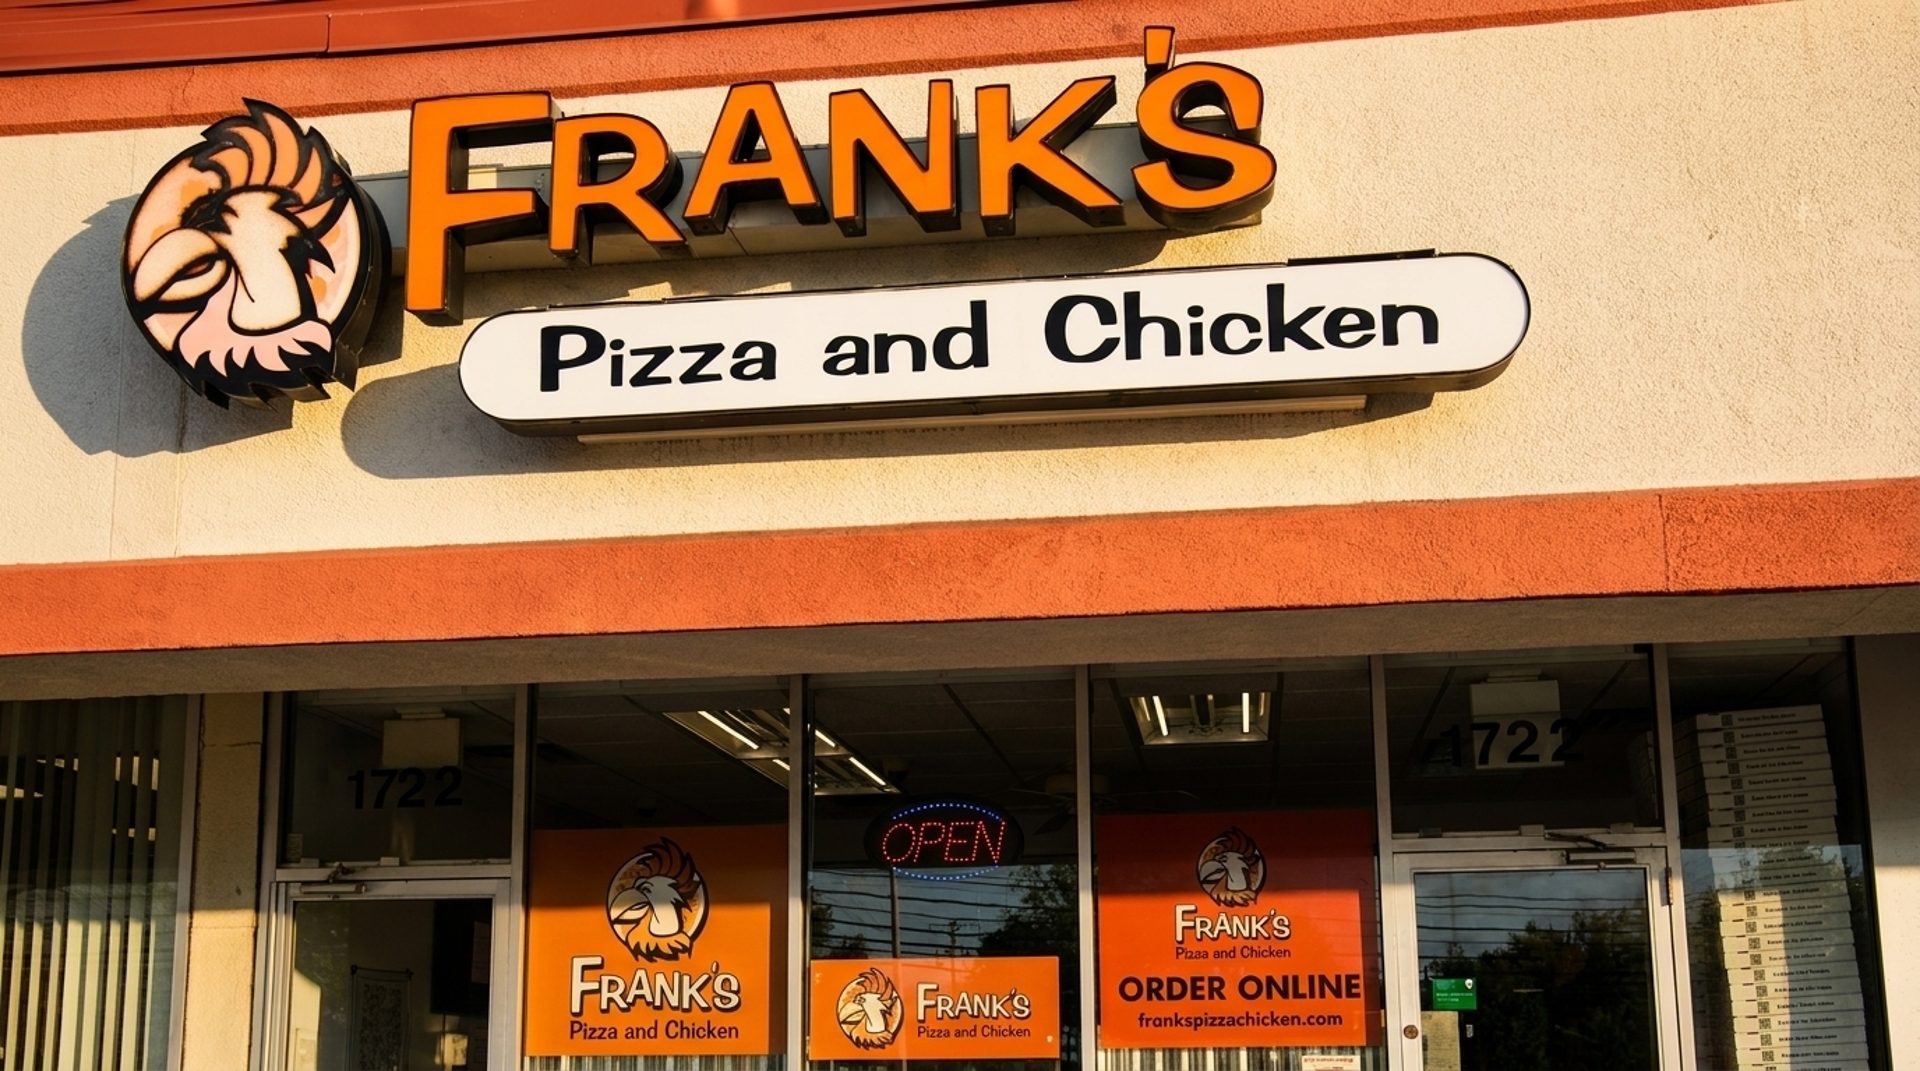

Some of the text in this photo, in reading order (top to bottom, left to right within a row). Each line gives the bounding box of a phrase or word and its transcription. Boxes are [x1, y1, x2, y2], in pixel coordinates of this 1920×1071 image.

[405, 26, 1277, 322] FRANK'S
[539, 283, 1440, 393] Pizza and Chicken
[1439, 717, 1585, 767] 1722
[347, 765, 463, 809] 1722
[882, 820, 1007, 864] OPEN
[1174, 903, 1292, 945] FRANK'S
[1212, 945, 1237, 959] and
[1240, 945, 1292, 959] Chicken
[570, 955, 742, 1018] FRANK'S
[916, 981, 1032, 1024] FRANK'S
[1118, 973, 1362, 1002] ORDER ONLINE
[569, 1019, 739, 1040] Pizza and Chicken
[917, 1024, 1031, 1039] Pizza and Chicken
[1137, 1010, 1344, 1031] frankspizzachicken.com
